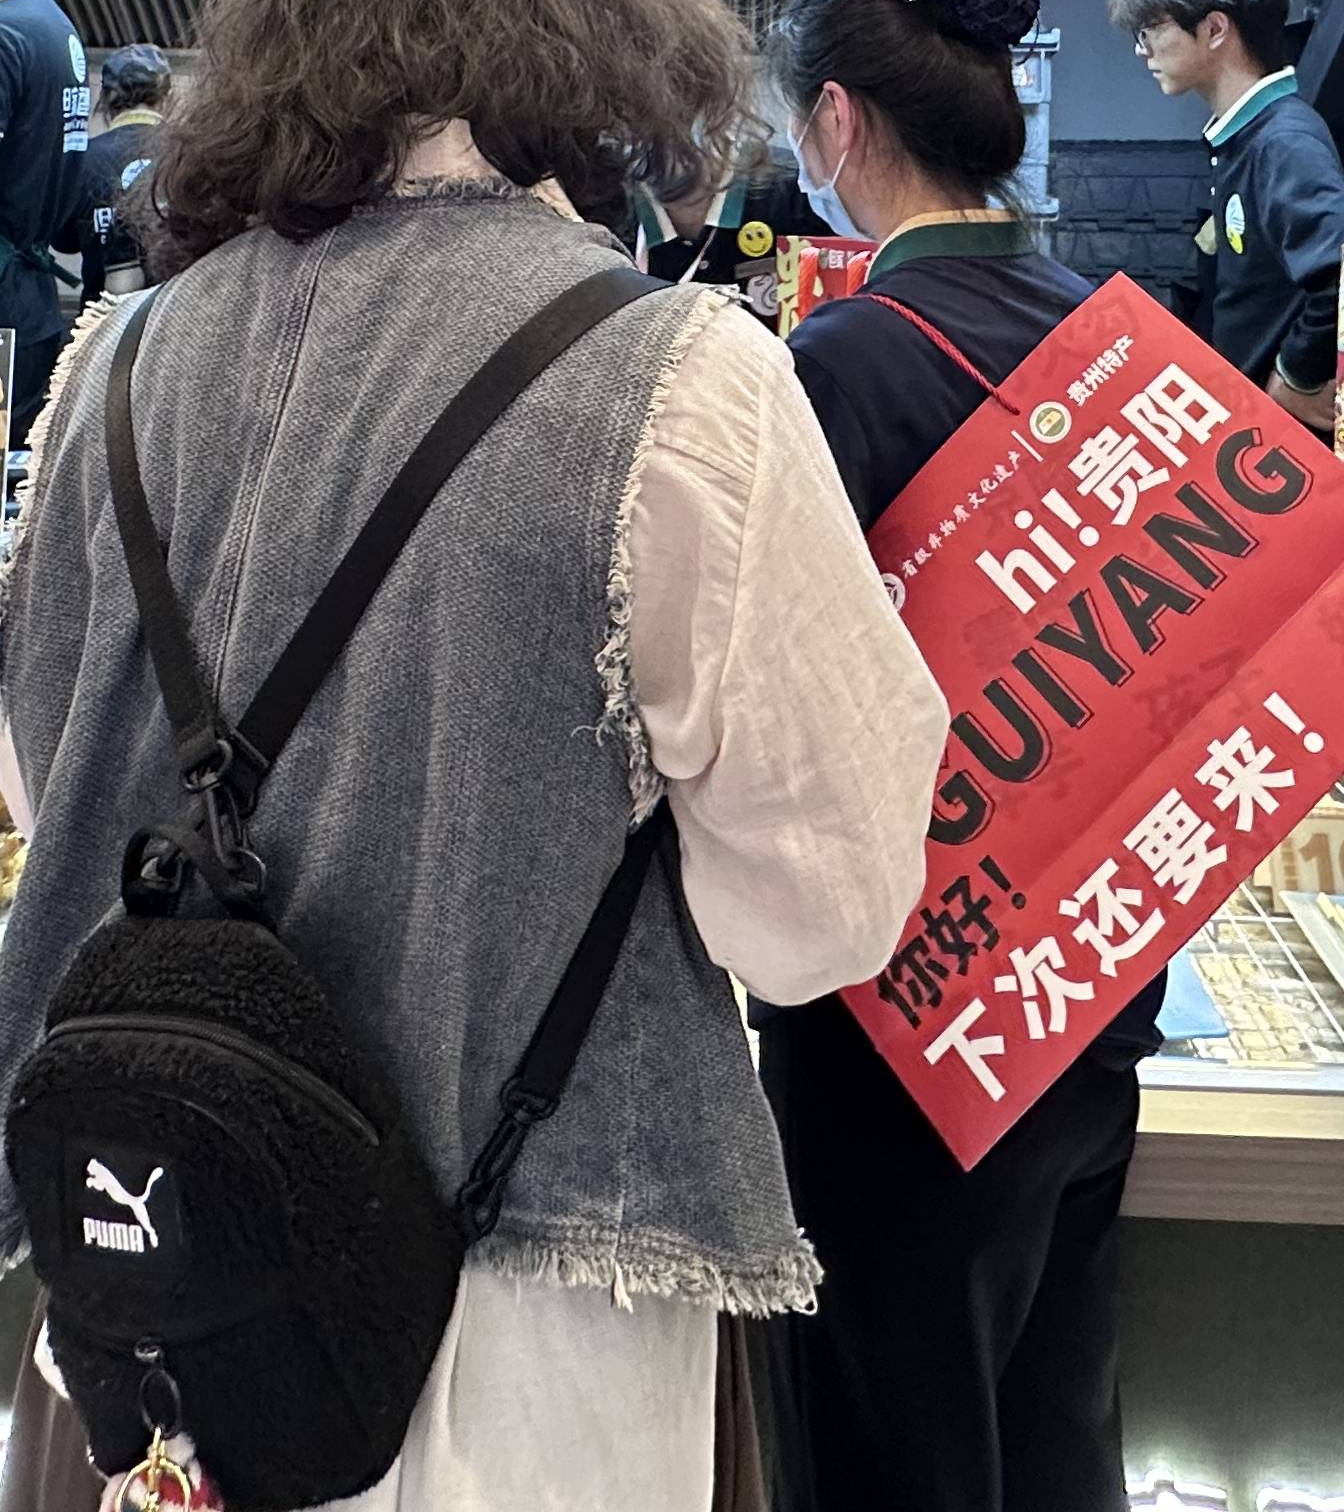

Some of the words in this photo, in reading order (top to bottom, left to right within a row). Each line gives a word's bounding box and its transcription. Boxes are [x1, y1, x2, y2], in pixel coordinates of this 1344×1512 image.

[1066, 334, 1135, 407] 贵州特产
[925, 427, 1314, 848] GUIYANG
[82, 1217, 145, 1254] PUMA
